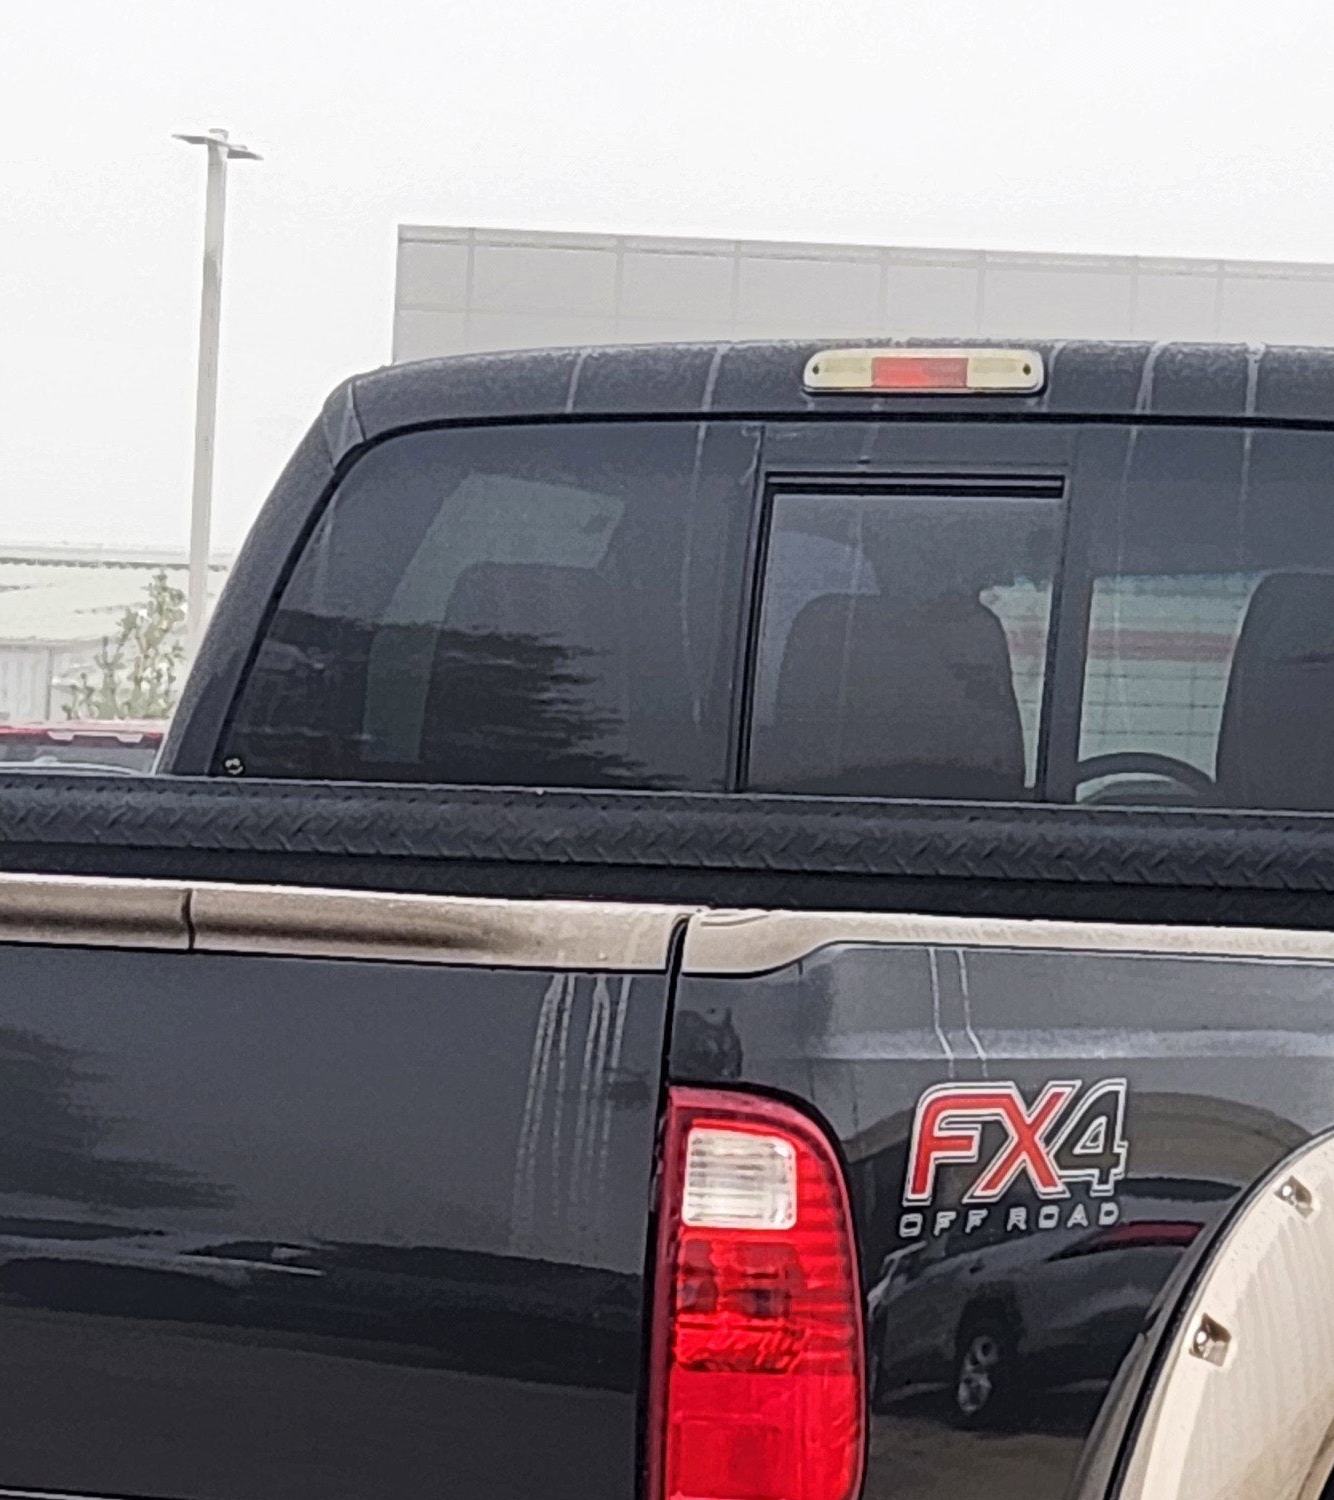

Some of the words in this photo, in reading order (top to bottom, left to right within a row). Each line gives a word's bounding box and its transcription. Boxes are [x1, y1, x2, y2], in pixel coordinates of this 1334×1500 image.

[902, 1077, 1129, 1207] FX4
[899, 1208, 989, 1238] OFF
[1006, 1202, 1120, 1232] ROAD
